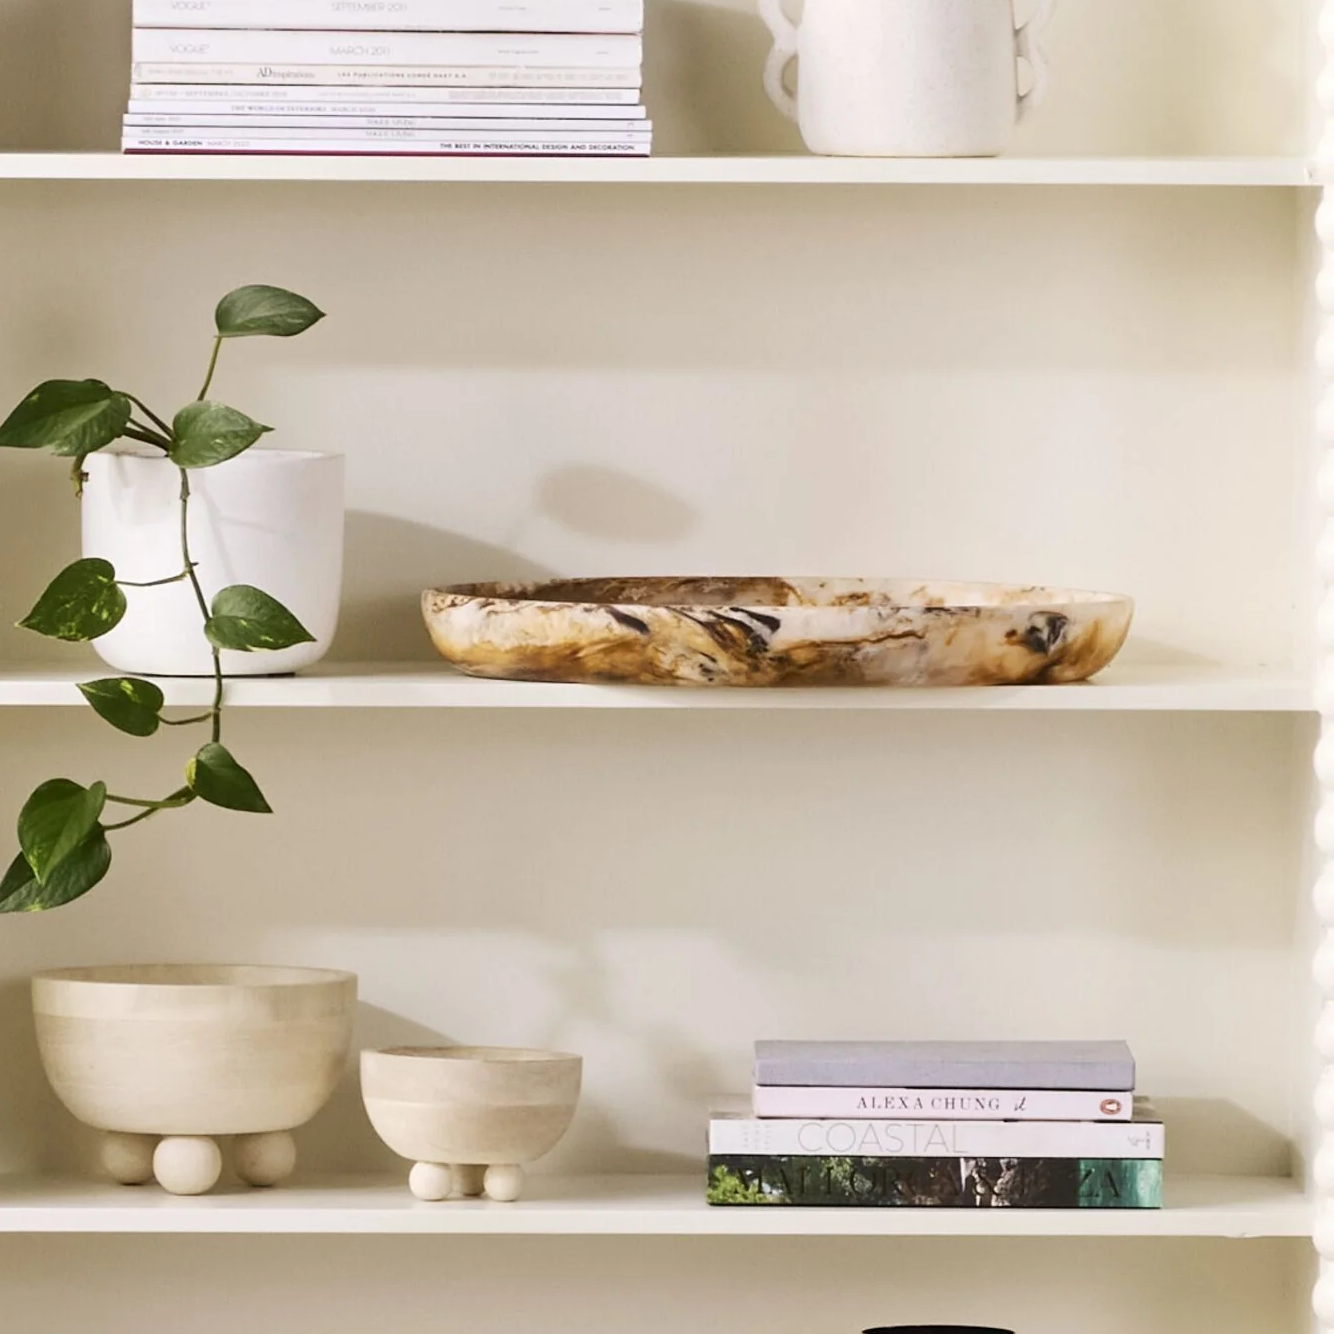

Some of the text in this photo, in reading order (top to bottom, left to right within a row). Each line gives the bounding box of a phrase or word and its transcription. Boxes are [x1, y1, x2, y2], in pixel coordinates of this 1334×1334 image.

[331, 1, 385, 12] SEPTEMBER
[328, 45, 369, 56] MARCH
[454, 142, 471, 150] BEST
[483, 143, 539, 151] INTERNATIONAL
[588, 144, 635, 152] DECORATION
[857, 1096, 924, 1110] ALEXA
[931, 1097, 1000, 1111] CHUNG
[798, 1123, 969, 1154] COASTAL
